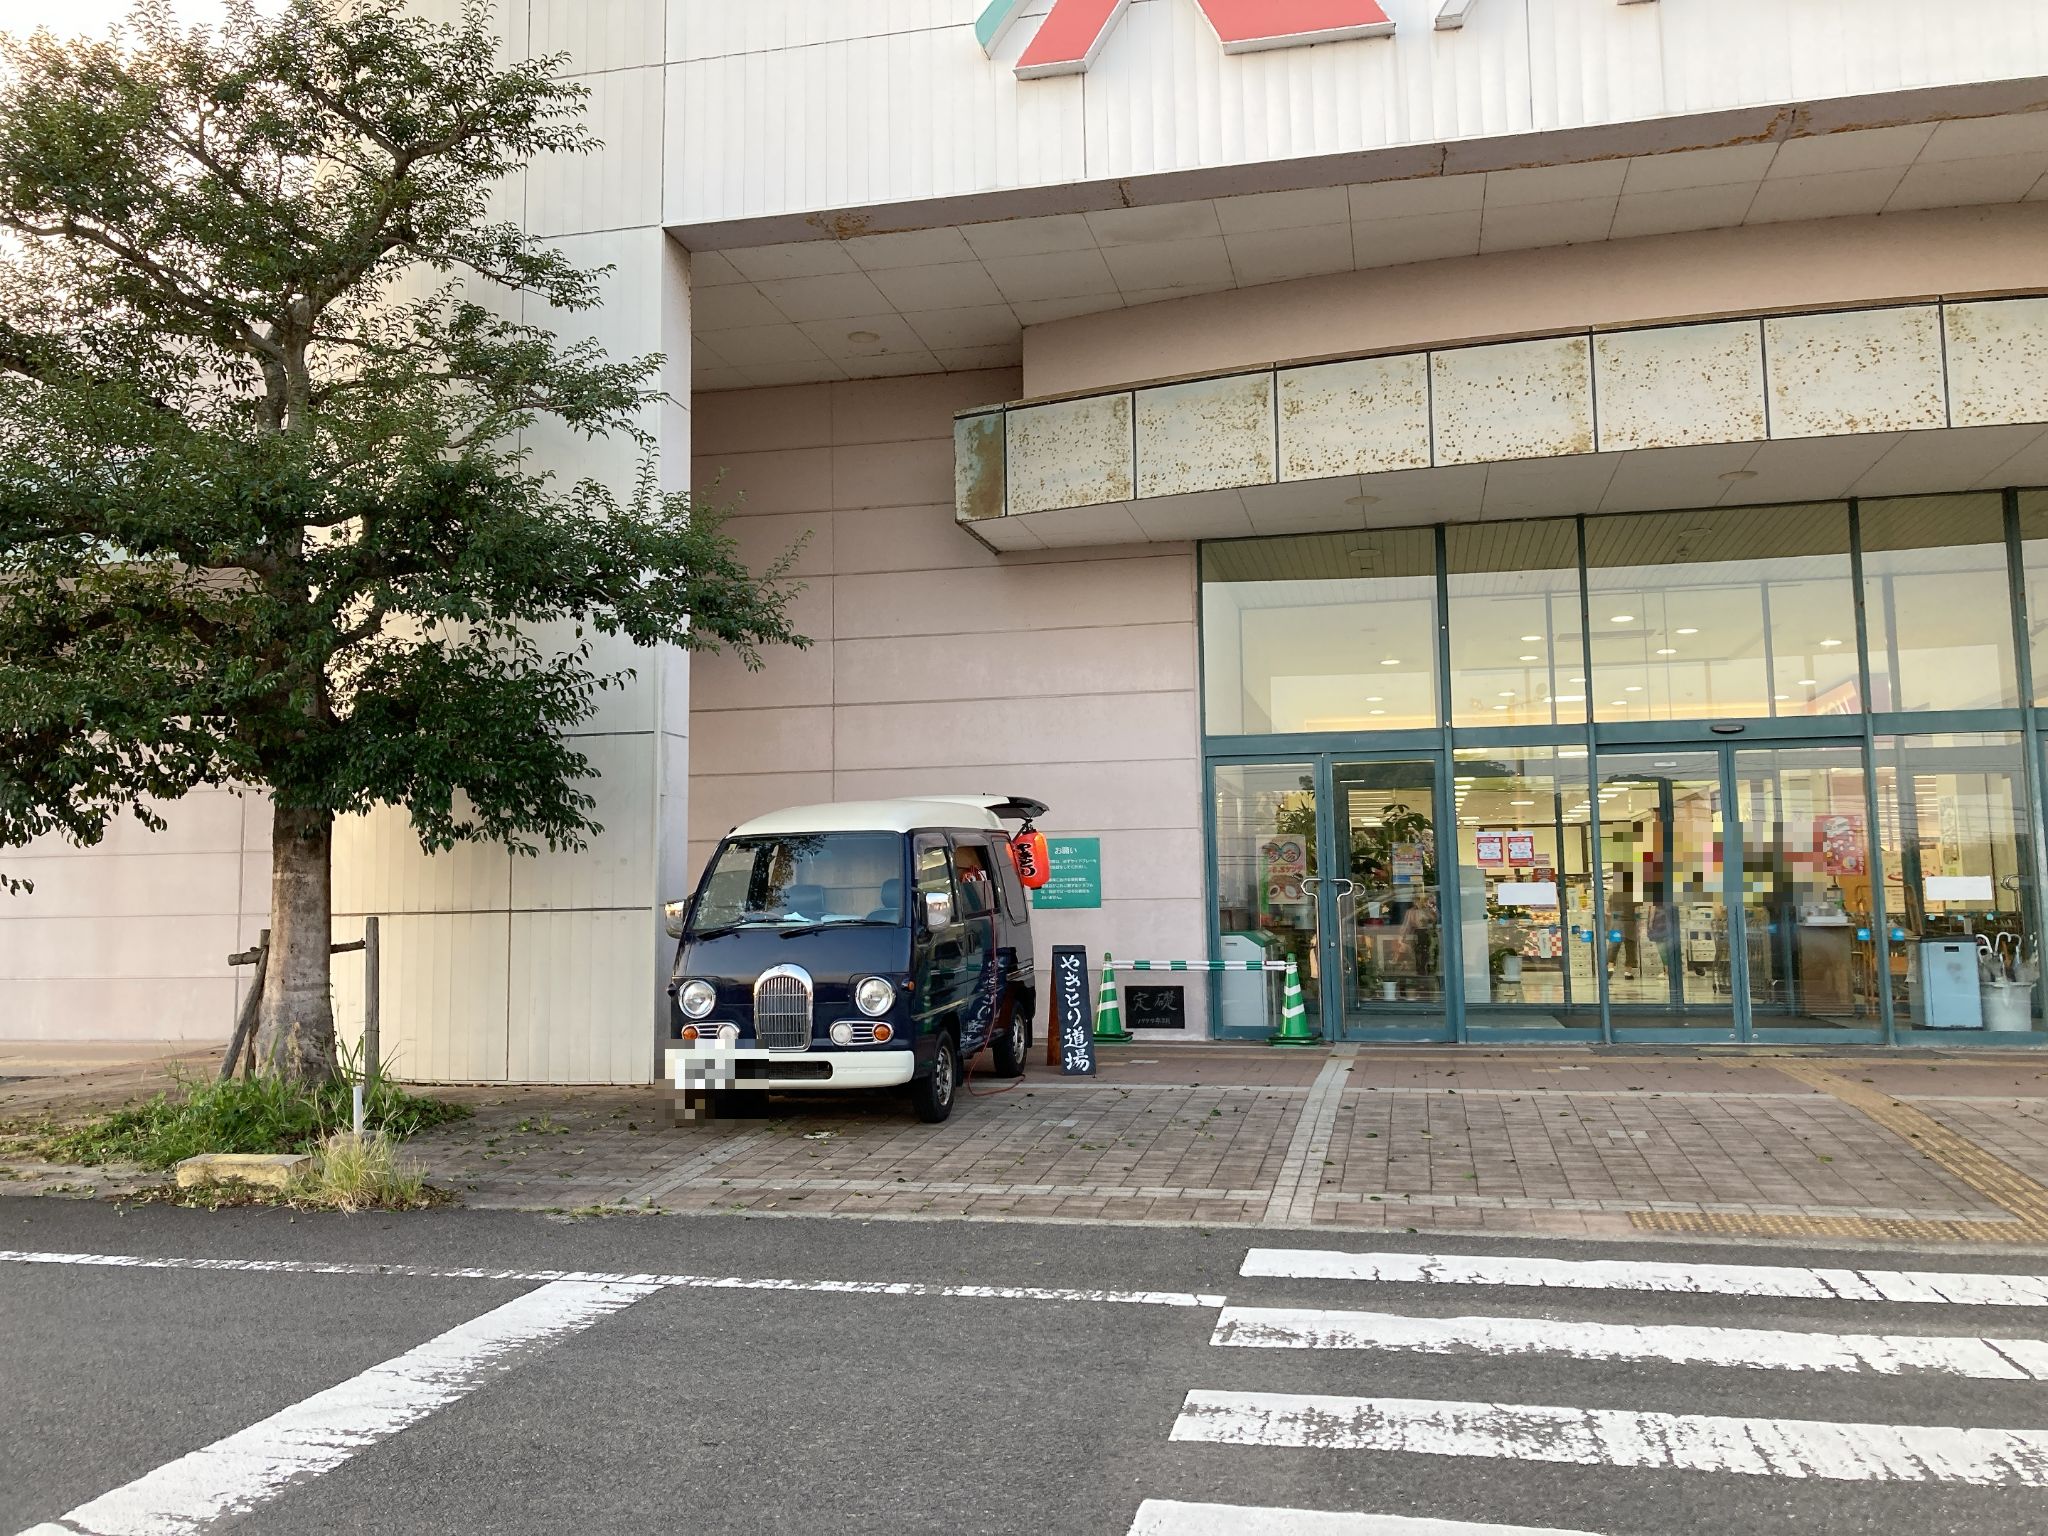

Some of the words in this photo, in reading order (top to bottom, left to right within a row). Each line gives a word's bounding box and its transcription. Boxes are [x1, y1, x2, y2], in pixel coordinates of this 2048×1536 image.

[1060, 954, 1090, 1071] やきとり道場
[1132, 991, 1178, 1011] 定礎
